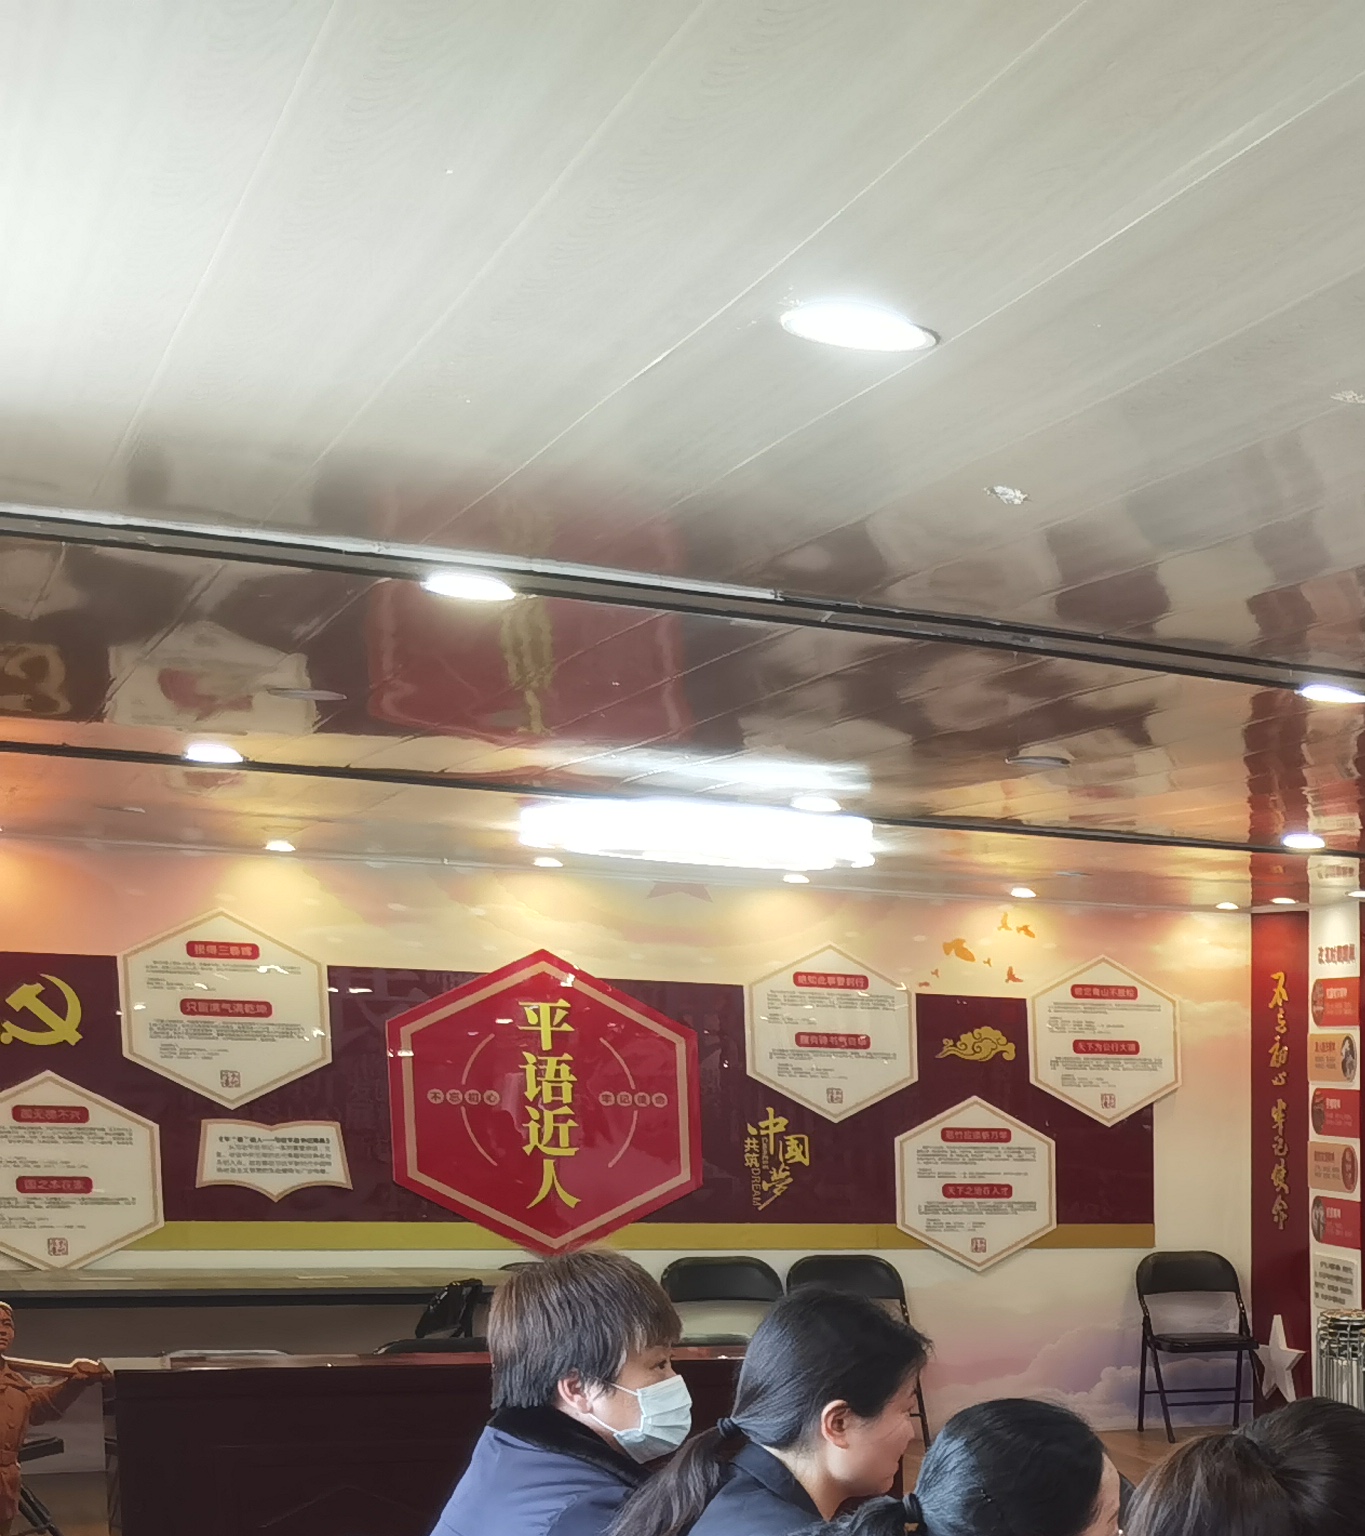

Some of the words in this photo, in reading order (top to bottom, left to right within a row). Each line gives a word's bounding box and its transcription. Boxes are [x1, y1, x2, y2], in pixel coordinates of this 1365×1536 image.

[1268, 971, 1289, 1086] 不忘初心
[517, 999, 581, 1209] 平语近人
[1271, 1098, 1289, 1230] 牢记使命
[751, 1168, 761, 1206] DREAM
